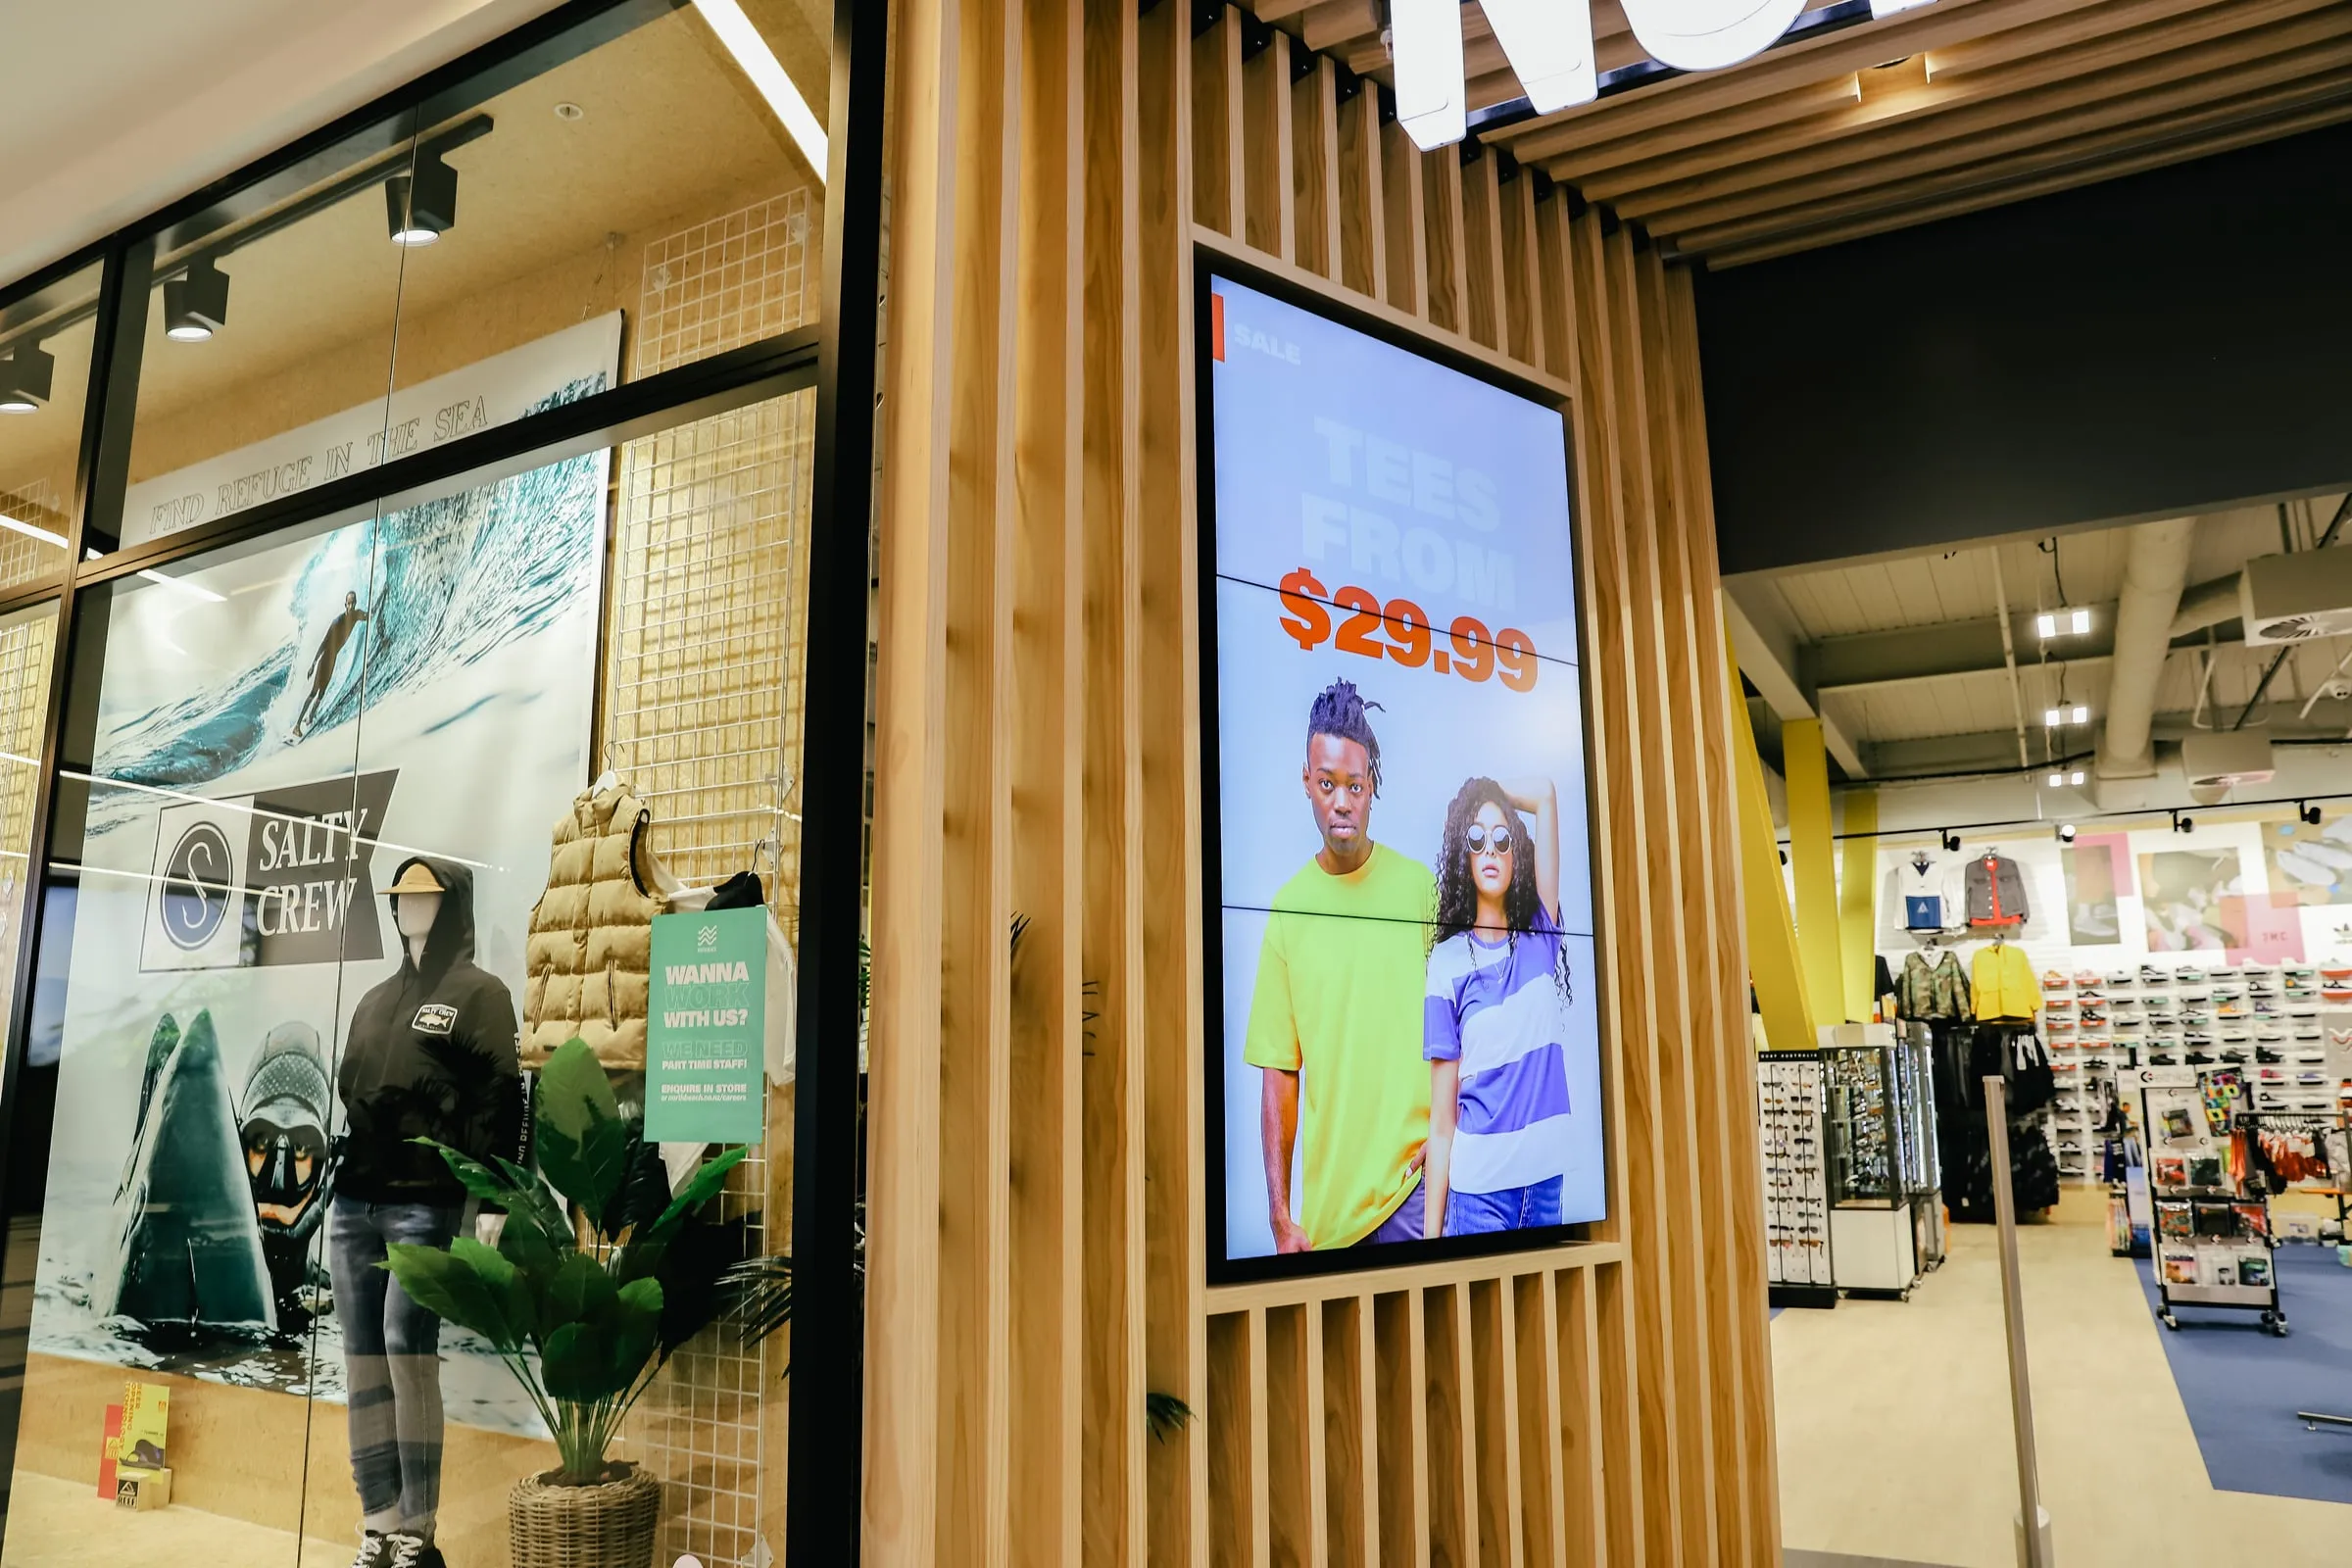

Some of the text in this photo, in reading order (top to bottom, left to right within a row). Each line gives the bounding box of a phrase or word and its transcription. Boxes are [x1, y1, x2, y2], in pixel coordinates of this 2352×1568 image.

[1233, 322, 1301, 366] SALE
[149, 395, 489, 535] FIND REFUGE IN THE SEA
[1313, 415, 1501, 533] TEES
[1301, 492, 1516, 612] FROM
[1278, 566, 1539, 694] $29.99
[259, 808, 368, 871] SALTY
[257, 877, 358, 937] CREW
[665, 961, 750, 986] WANNA
[663, 1008, 748, 1028] WITH US?
[664, 982, 750, 1011] WORK
[662, 1039, 748, 1058] WE NEED
[662, 1058, 747, 1070] PART TIME STAFF!
[661, 1083, 747, 1094] ENQUIRE IN STORE
[127, 1383, 136, 1430] OPENING
